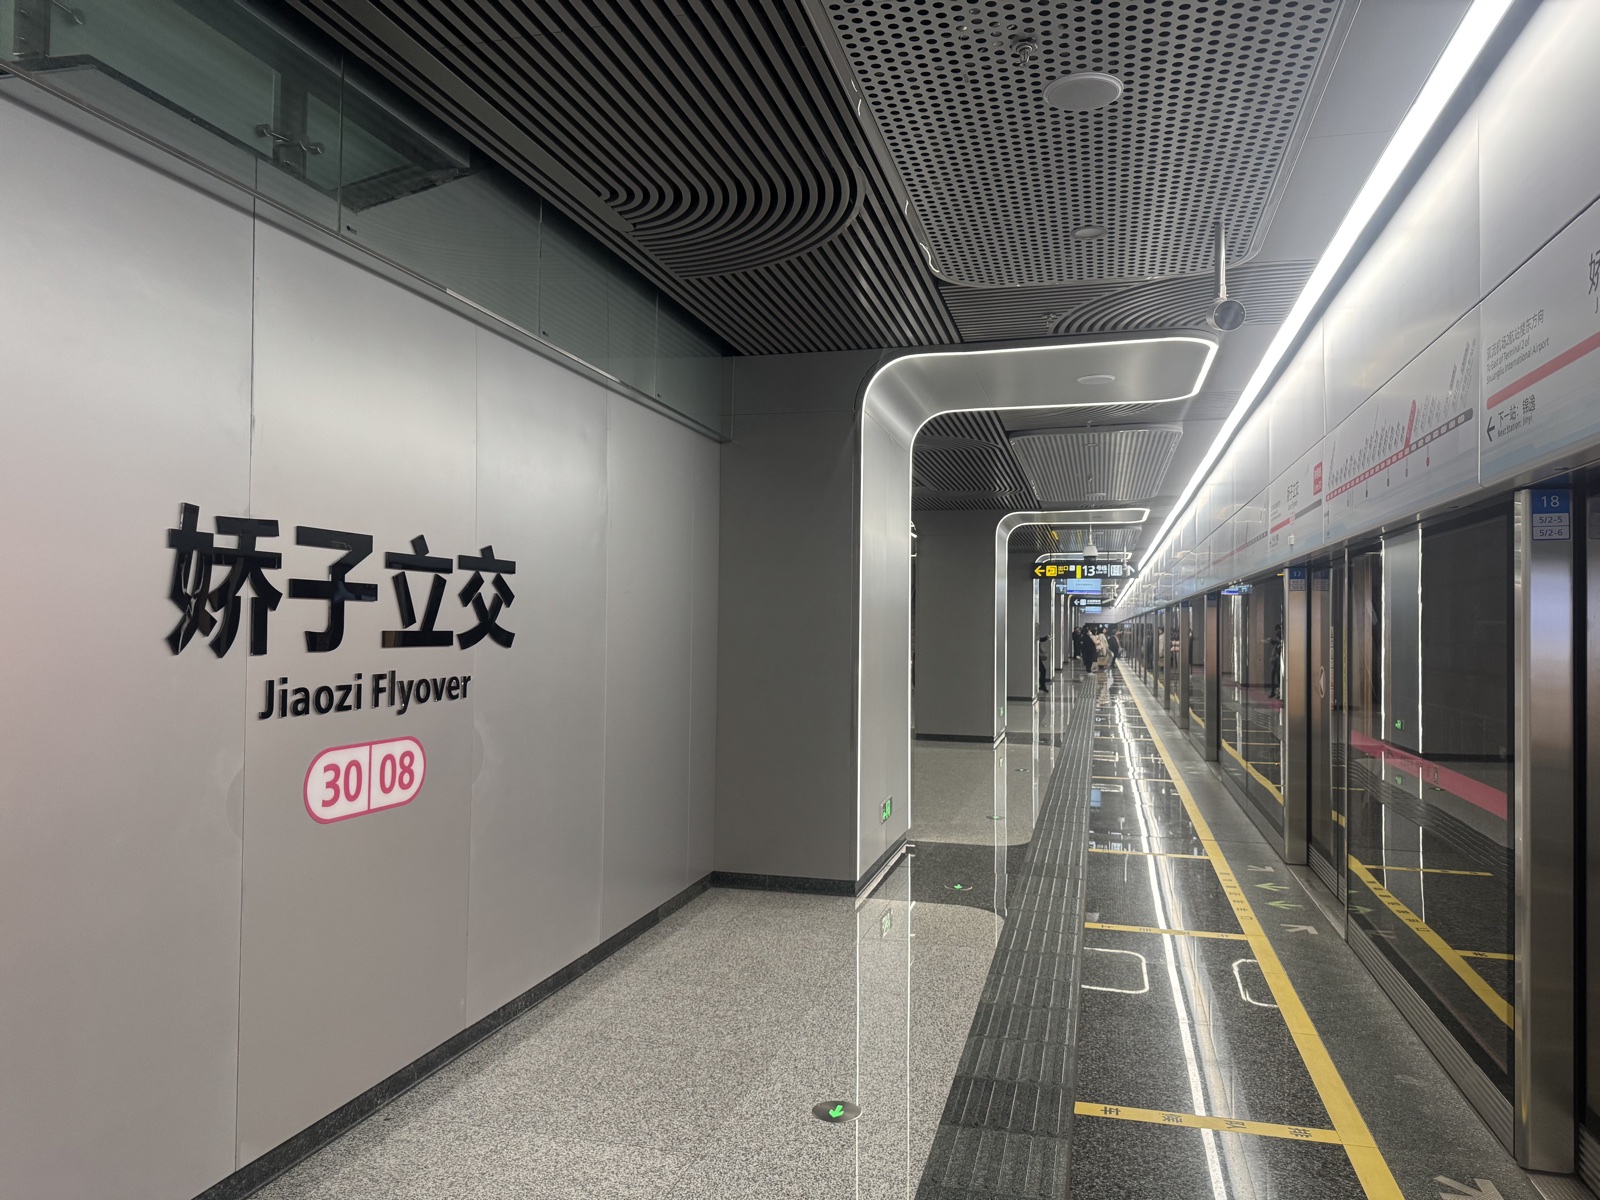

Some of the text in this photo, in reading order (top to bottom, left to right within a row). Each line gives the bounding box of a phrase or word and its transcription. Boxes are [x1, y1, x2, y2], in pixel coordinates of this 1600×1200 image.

[1541, 495, 1560, 508] 18
[1539, 516, 1563, 524] 5/2-5
[1539, 529, 1563, 537] 5/2-6
[166, 502, 516, 658] 娇子立交
[259, 670, 472, 720] Jiaozi Flyover
[321, 750, 415, 808] 30 08
